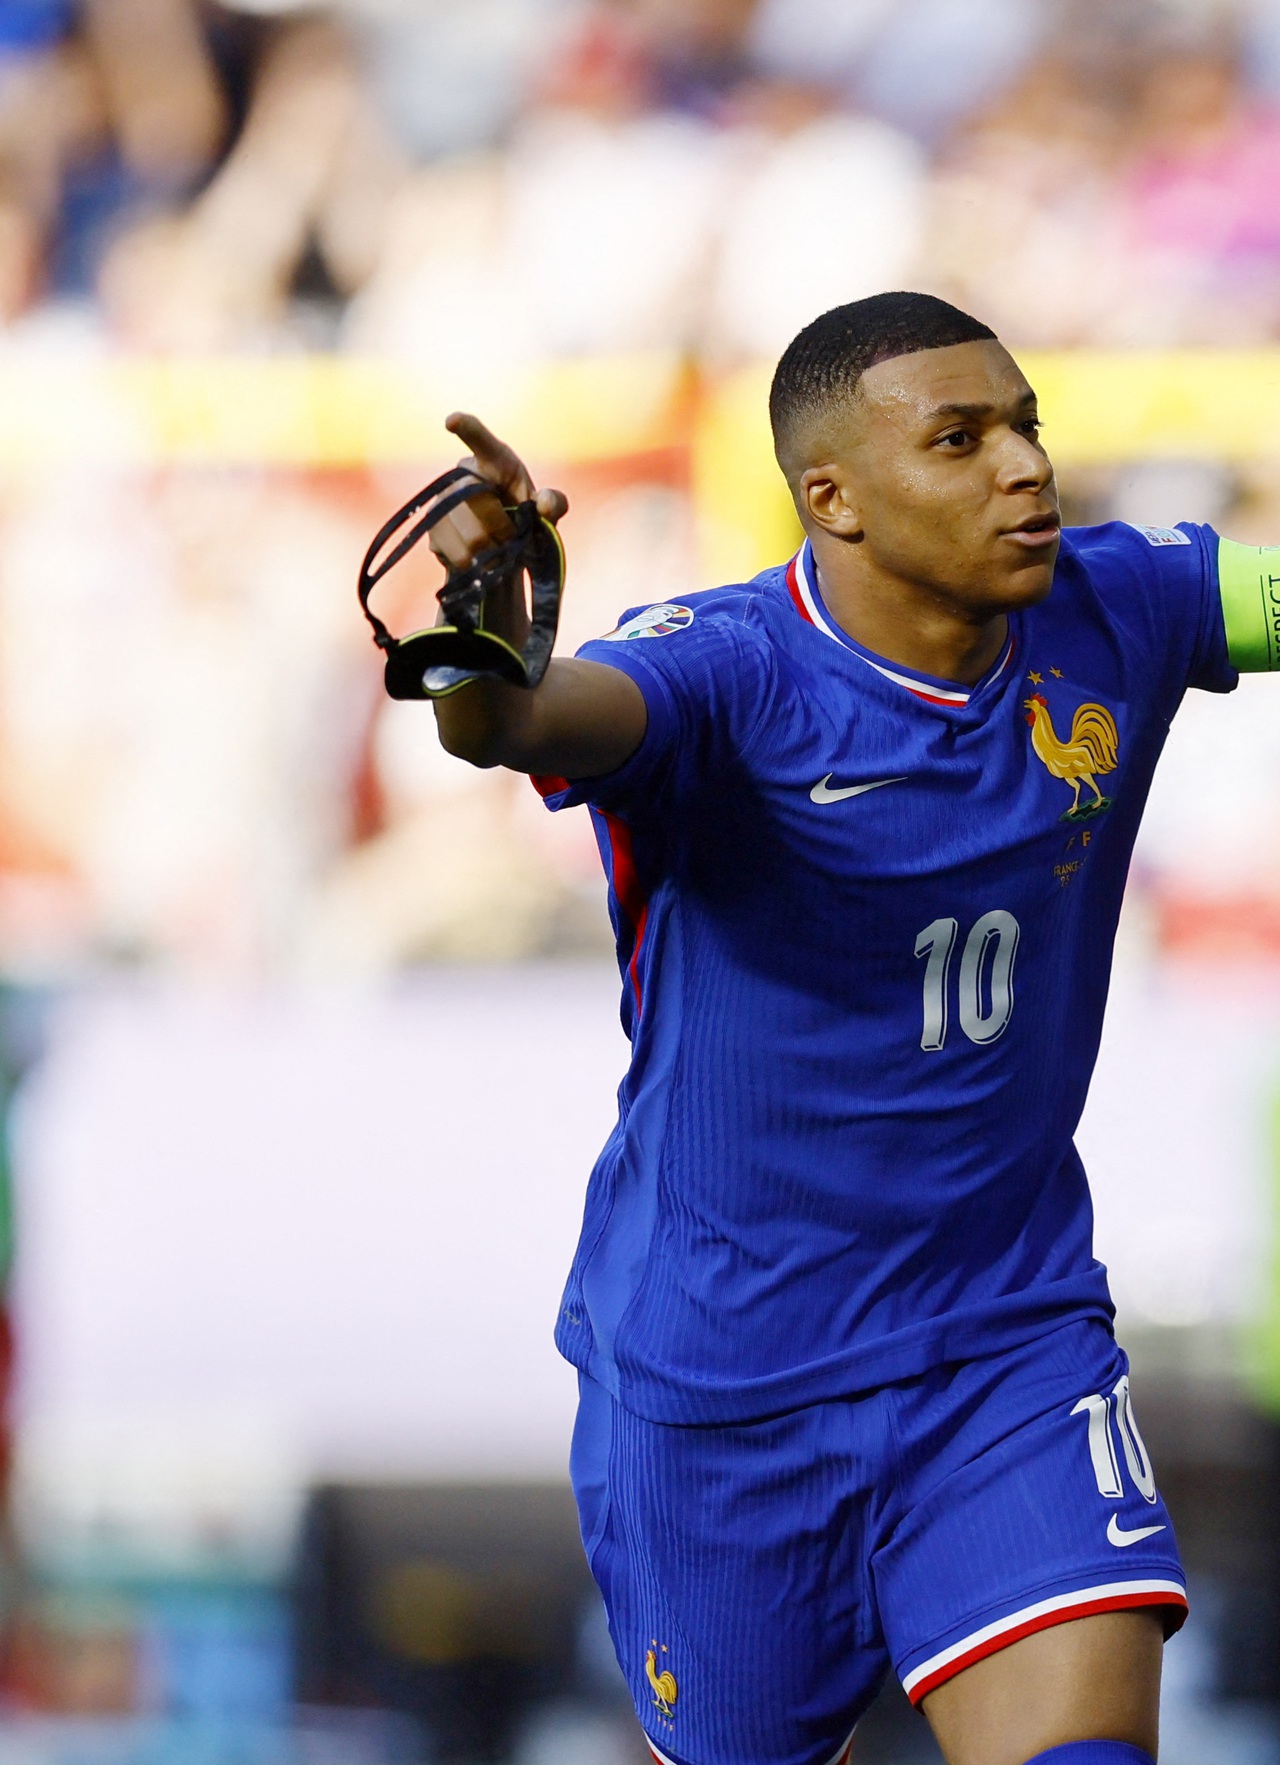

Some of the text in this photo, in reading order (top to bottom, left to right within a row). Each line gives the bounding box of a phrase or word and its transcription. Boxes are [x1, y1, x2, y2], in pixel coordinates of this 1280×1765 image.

[1053, 860, 1079, 878] FRANCE
[914, 909, 1020, 1052] 10
[1069, 1374, 1157, 1505] 10
